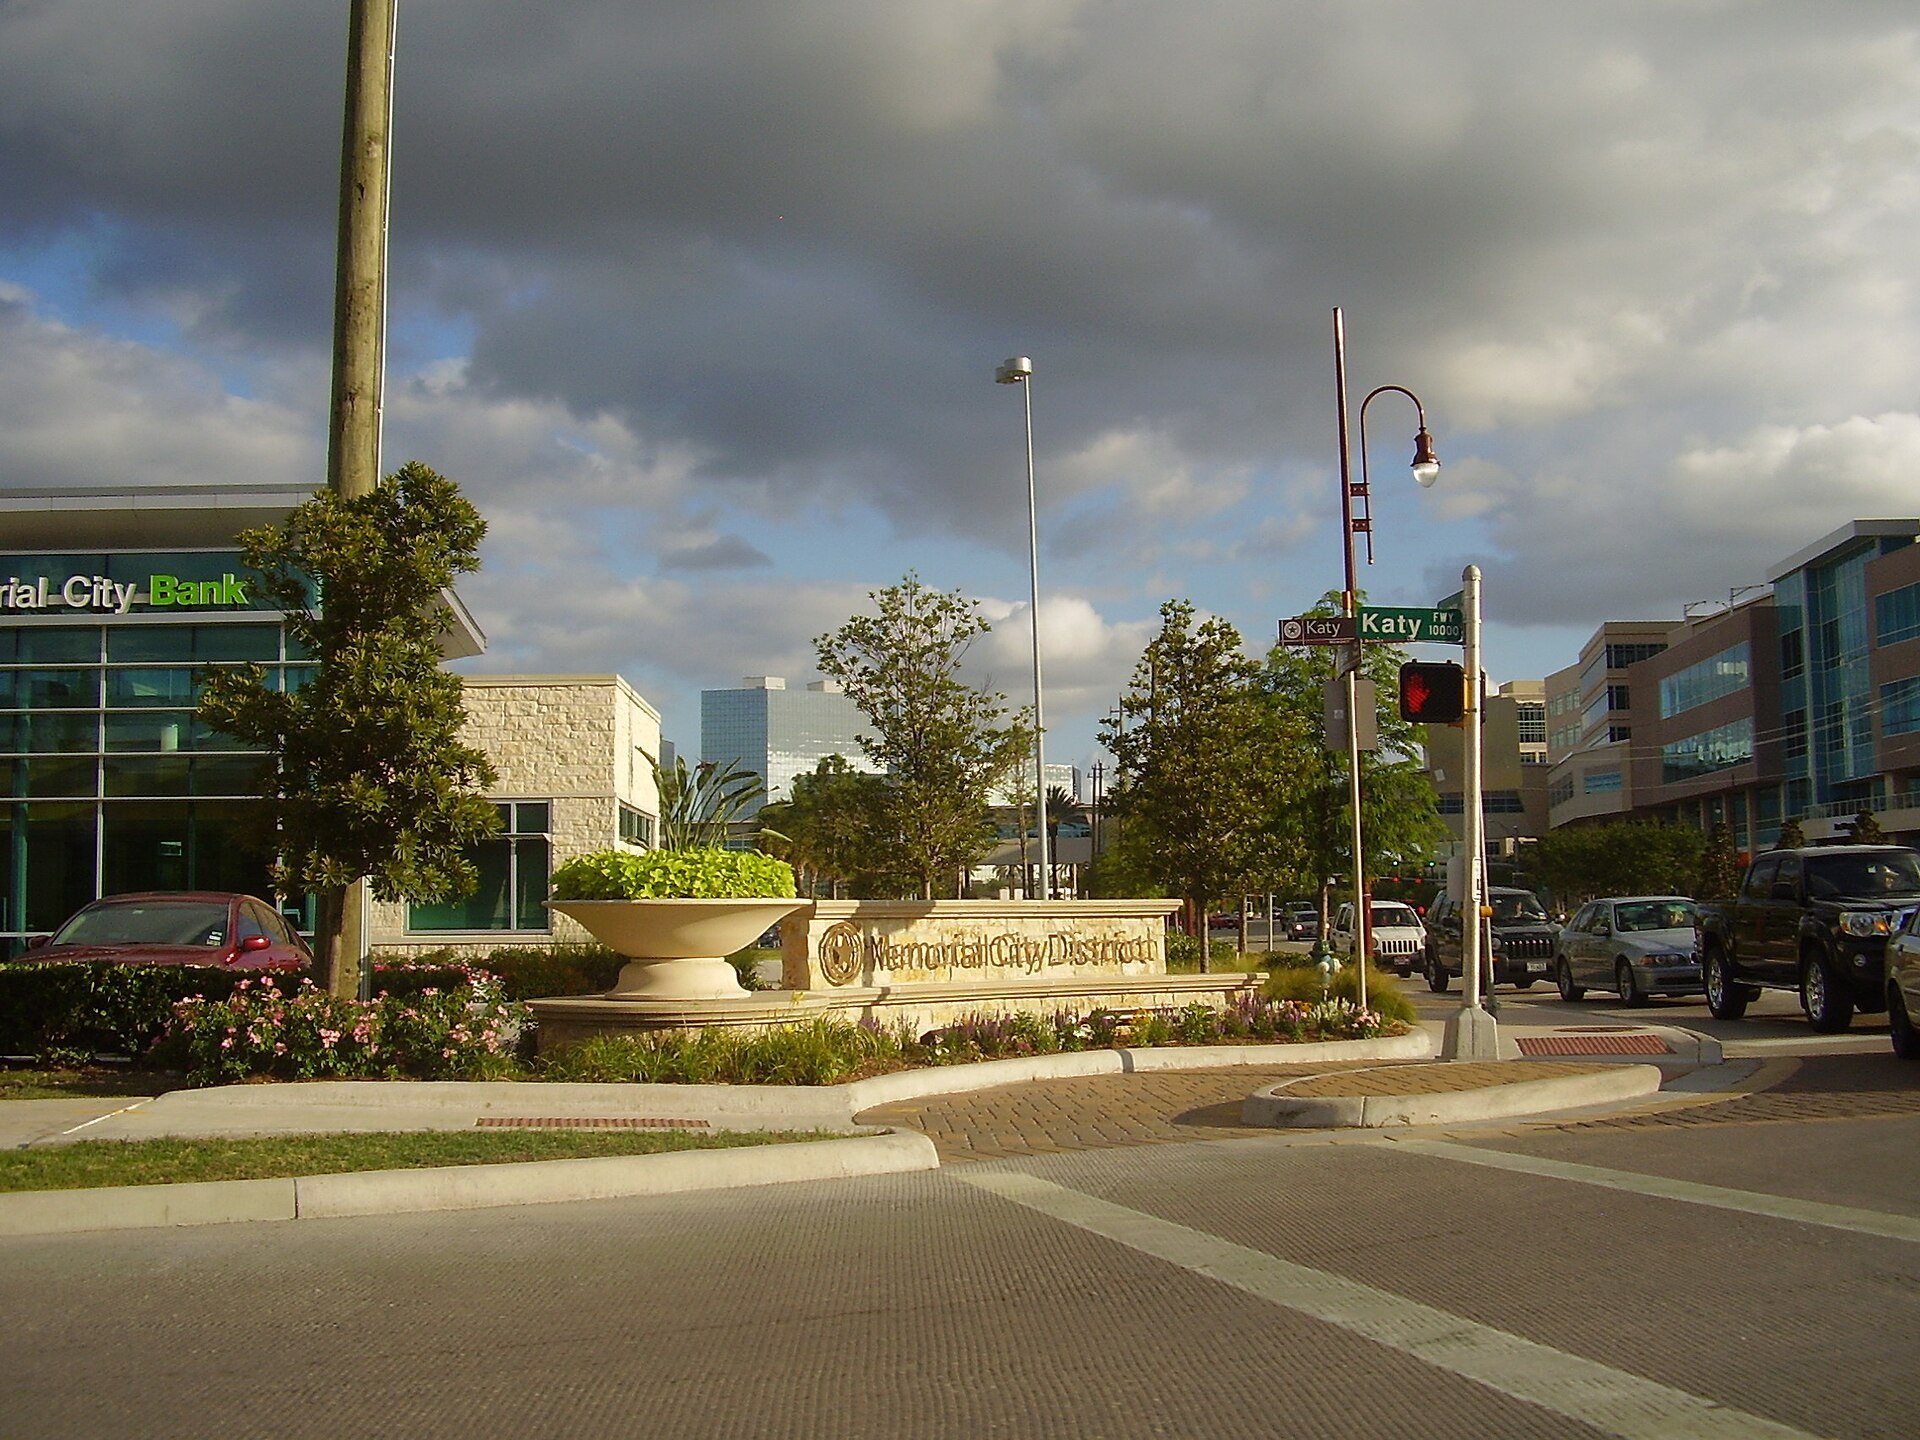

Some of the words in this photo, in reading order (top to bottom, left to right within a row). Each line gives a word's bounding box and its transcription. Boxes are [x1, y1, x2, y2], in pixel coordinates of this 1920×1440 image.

[64, 575, 137, 614] City
[150, 573, 249, 606] Bank
[1306, 620, 1341, 637] Katy
[1362, 613, 1421, 638] Katy
[1433, 612, 1453, 622] FWY
[1429, 624, 1459, 636] 10000
[871, 933, 988, 971] Memorial
[989, 932, 1047, 975] City
[1048, 931, 1158, 966] District
